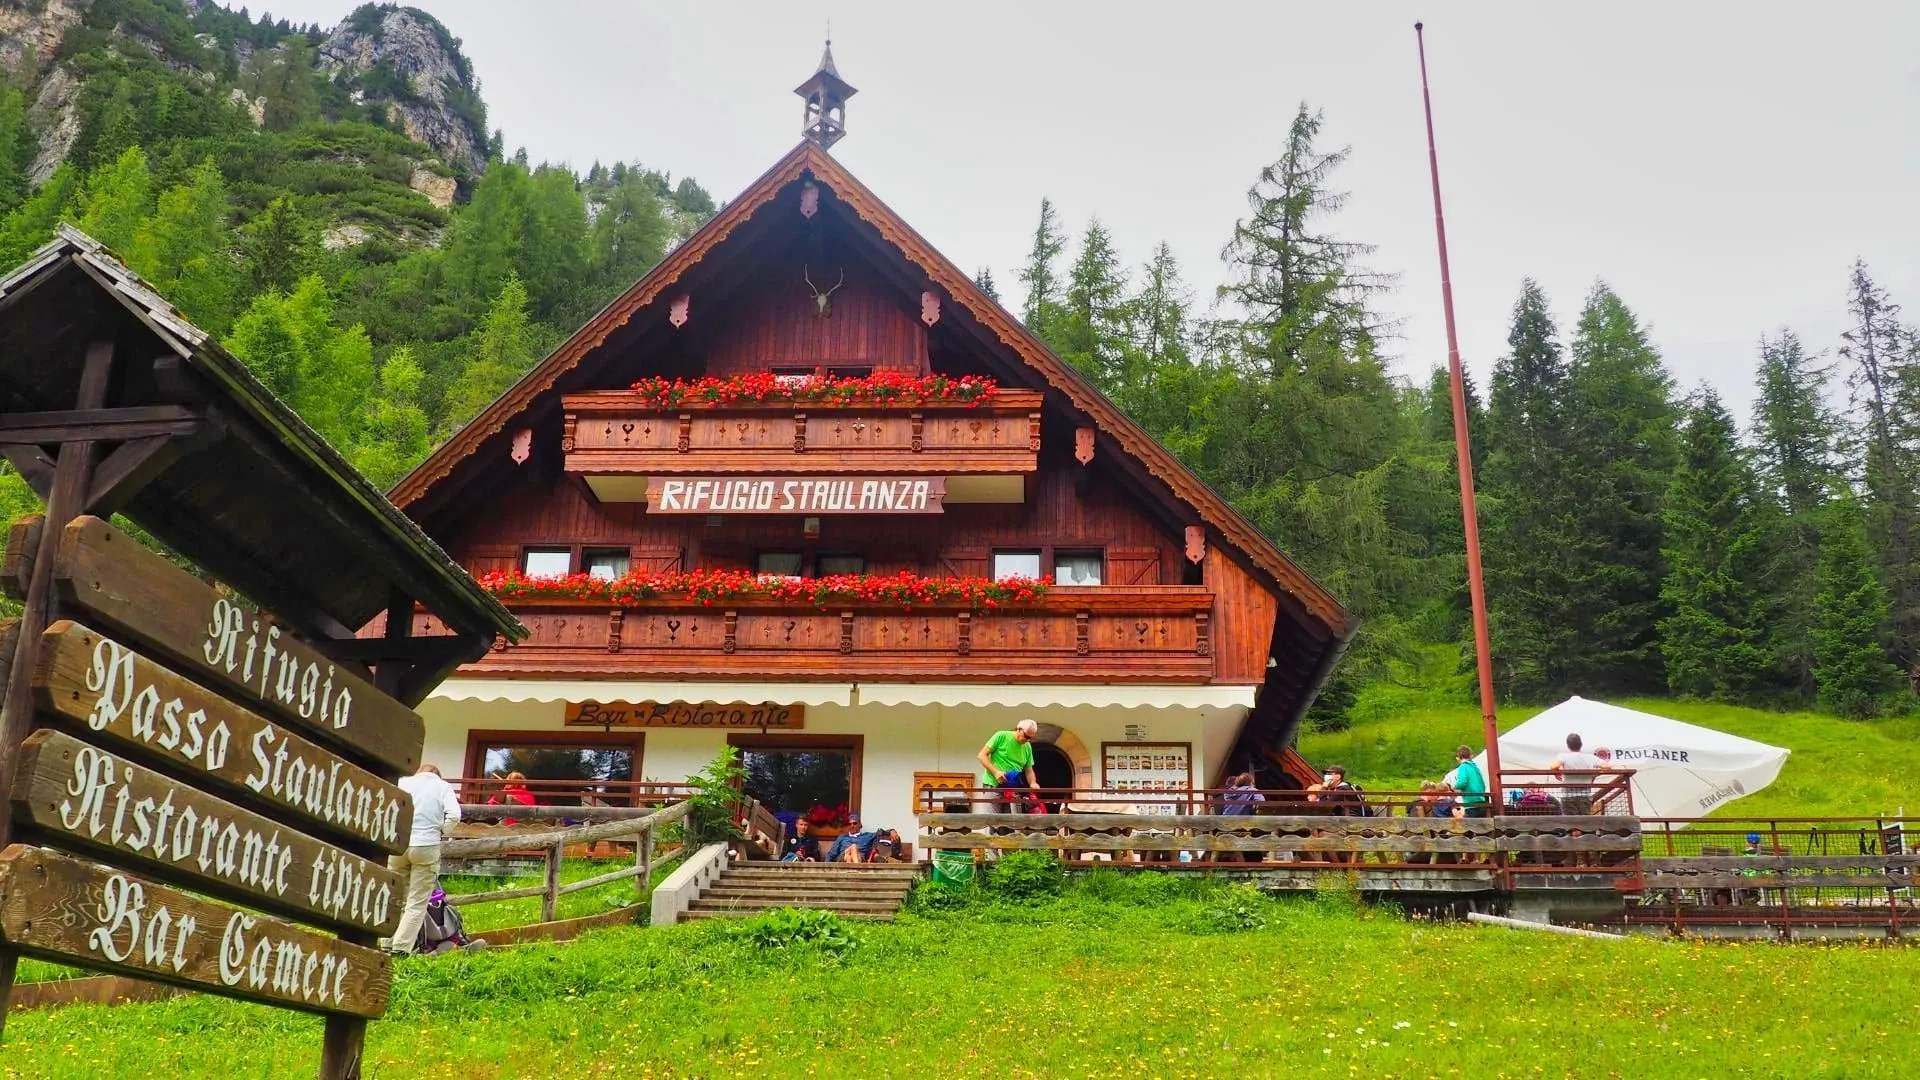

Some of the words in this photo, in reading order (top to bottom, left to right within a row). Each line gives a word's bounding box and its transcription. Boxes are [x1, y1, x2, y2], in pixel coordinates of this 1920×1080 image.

[780, 481, 929, 510] STAULANZA
[203, 599, 352, 729] Rifugio
[572, 704, 628, 724] Bar
[86, 638, 231, 771] Passo
[245, 724, 400, 843] Staulanza
[1615, 749, 1689, 762] PAULANER
[60, 747, 292, 897] Ristorante
[309, 846, 391, 927] tipico
[89, 874, 195, 973] Bar
[219, 911, 348, 1004] Camere
